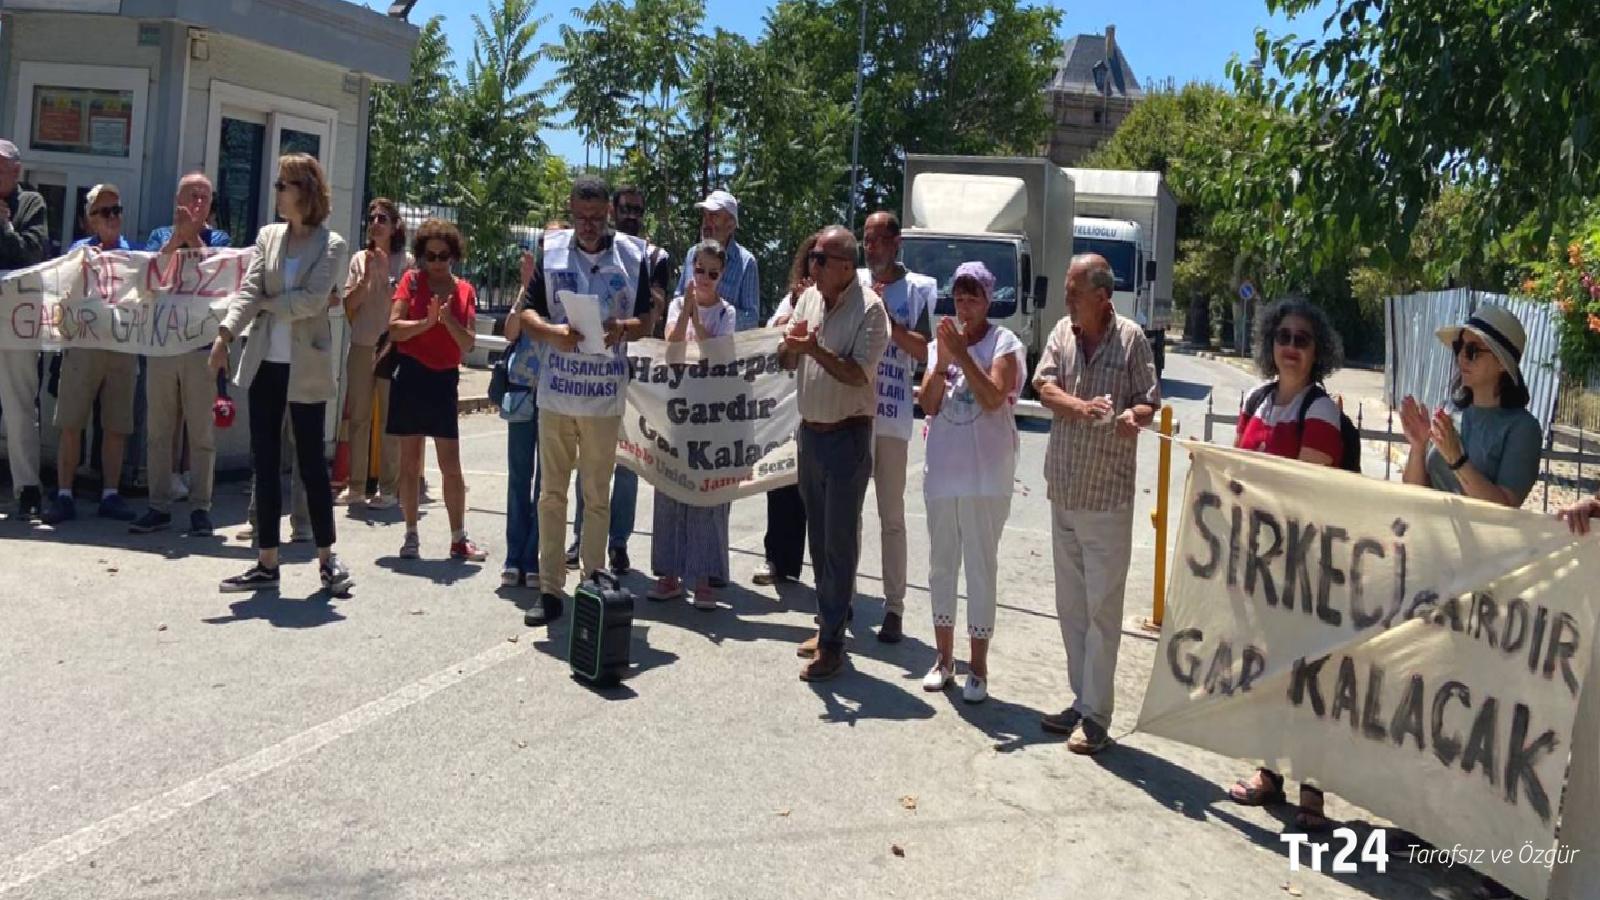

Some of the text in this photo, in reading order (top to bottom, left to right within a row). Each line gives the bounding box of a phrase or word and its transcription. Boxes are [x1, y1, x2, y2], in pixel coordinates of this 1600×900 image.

[550, 374, 618, 397] SENDİKASI
[629, 352, 795, 390] Haydarpa
[667, 393, 777, 426] Gardır
[1187, 479, 1409, 631] SİRKECİ
[1287, 653, 1561, 822] KALACAK
